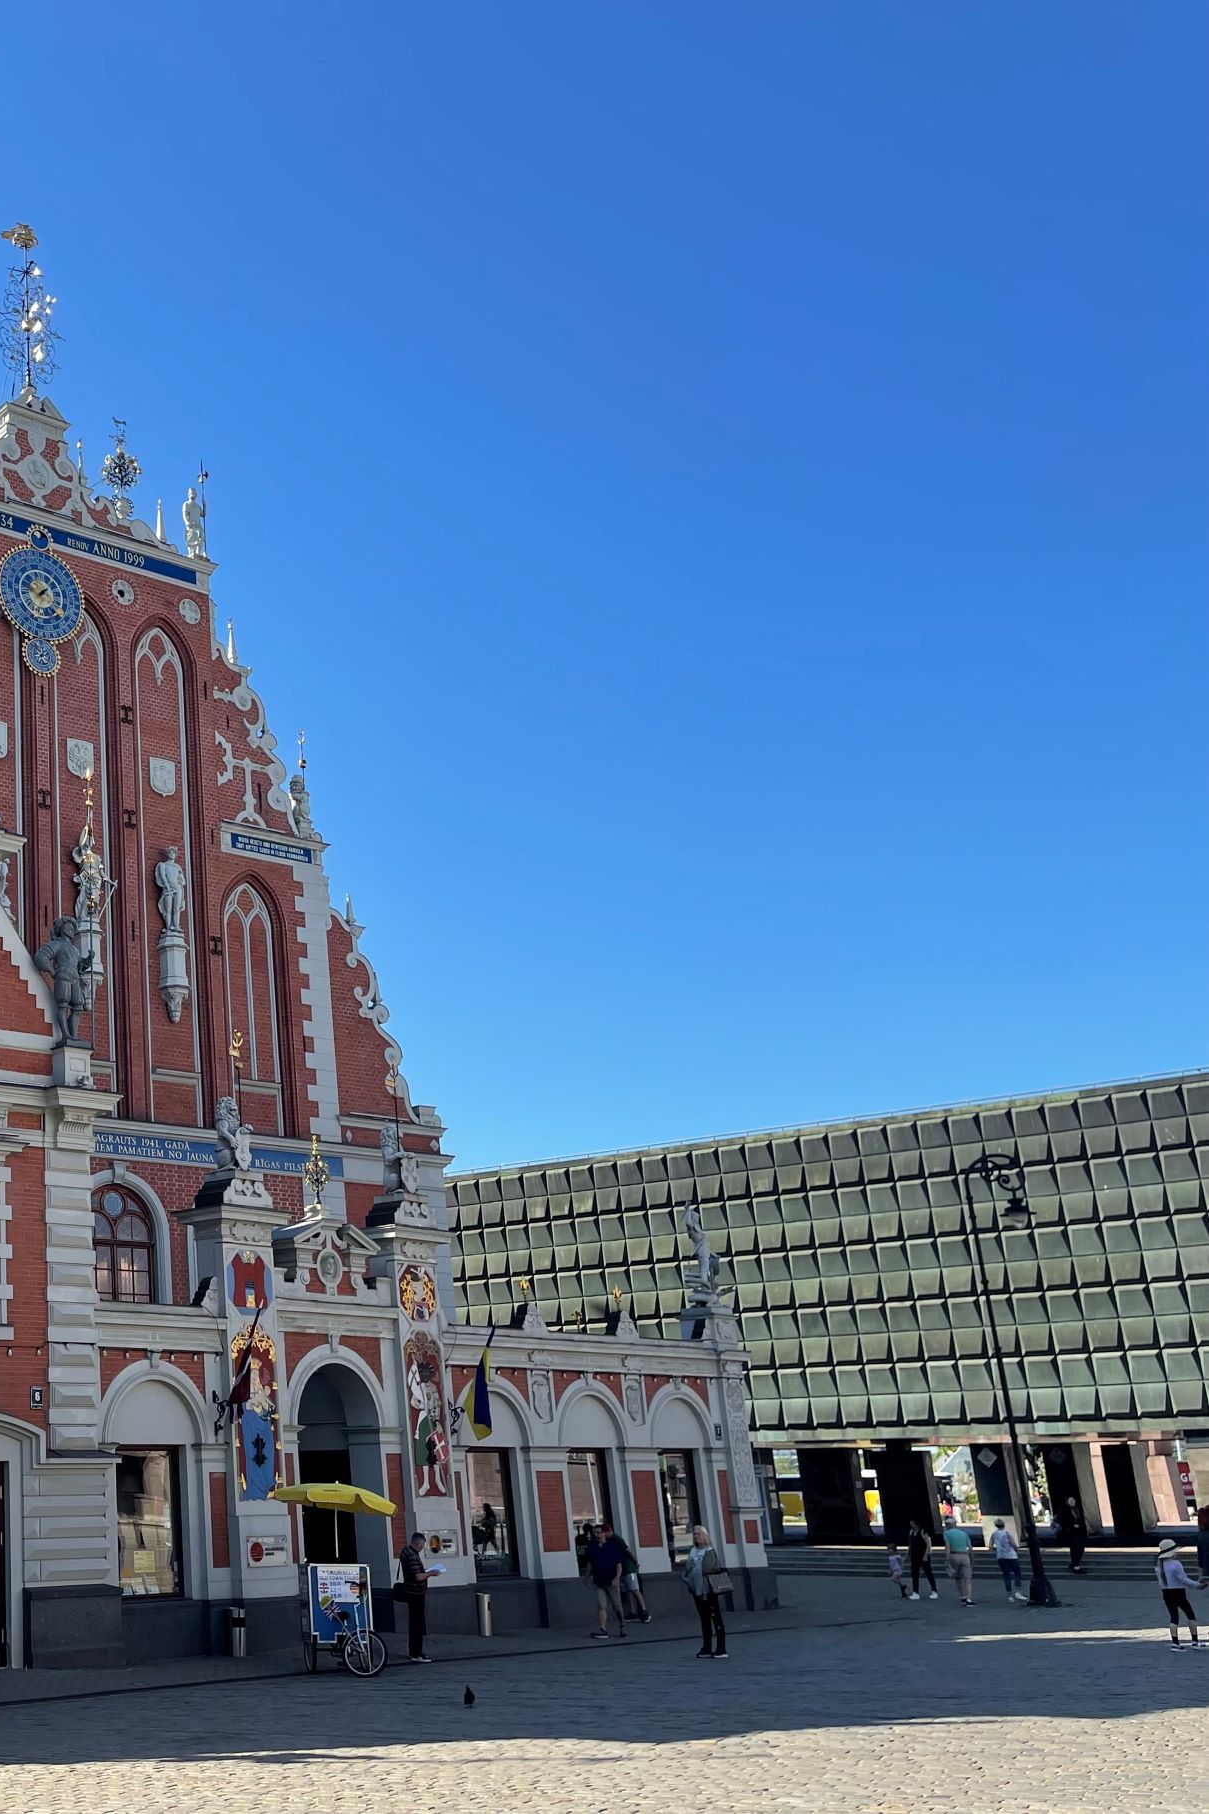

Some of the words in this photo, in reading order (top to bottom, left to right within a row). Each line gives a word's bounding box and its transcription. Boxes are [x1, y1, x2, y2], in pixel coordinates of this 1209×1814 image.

[66, 537, 90, 551] RENOV
[92, 543, 120, 562] ANNO
[123, 551, 145, 568] 1999
[118, 1146, 164, 1158] PAMATIEM
[168, 1150, 182, 1160] NO
[186, 1152, 215, 1163] JAUNA
[34, 1391, 41, 1402] 6
